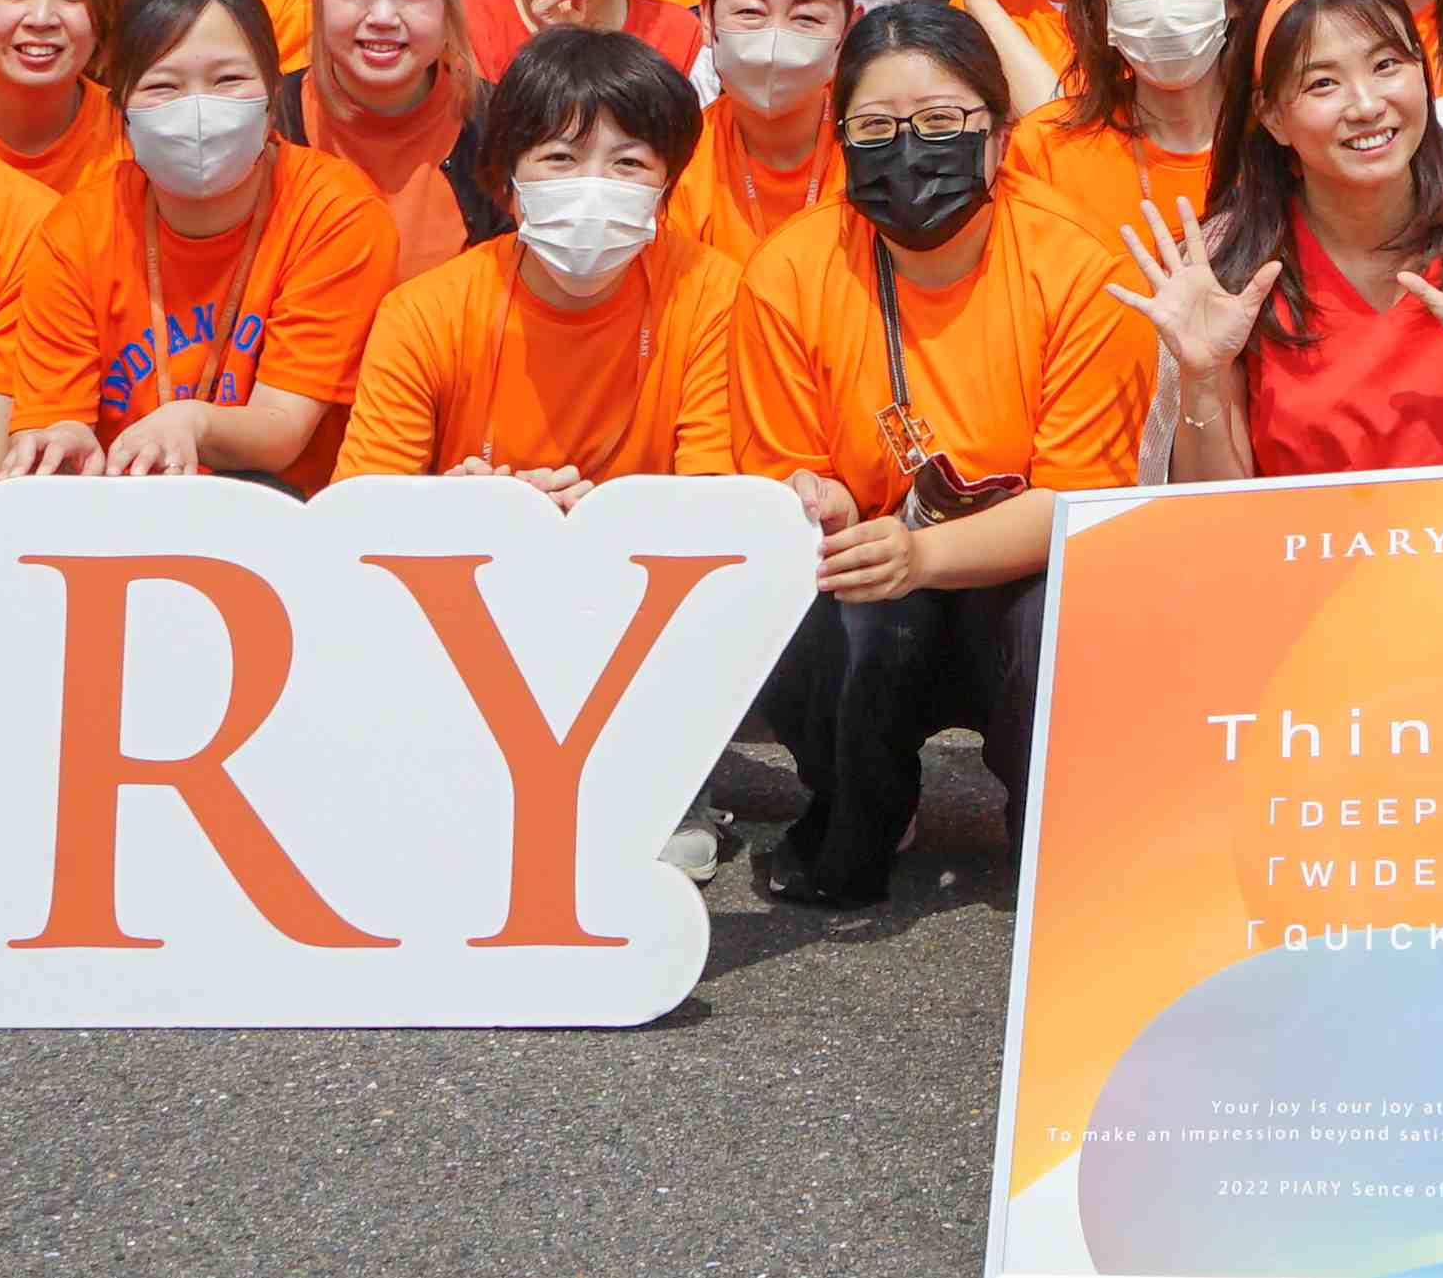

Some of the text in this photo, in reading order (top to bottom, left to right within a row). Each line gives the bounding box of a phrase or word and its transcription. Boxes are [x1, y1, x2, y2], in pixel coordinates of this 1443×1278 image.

[1211, 1099, 1260, 1115] Your
[1268, 1099, 1301, 1117] joy
[1310, 1099, 1328, 1115] is
[1337, 1101, 1373, 1115] our
[1381, 1100, 1414, 1117] joy
[1423, 1101, 1443, 1115] at
[1047, 1128, 1075, 1143] To
[1082, 1128, 1137, 1143] make
[1146, 1129, 1172, 1143] an
[1182, 1126, 1300, 1145] impression
[1310, 1126, 1391, 1146] beyond
[1217, 1180, 1270, 1196] 2022
[1279, 1180, 1342, 1197] PIARY
[1351, 1180, 1415, 1198] Sence
